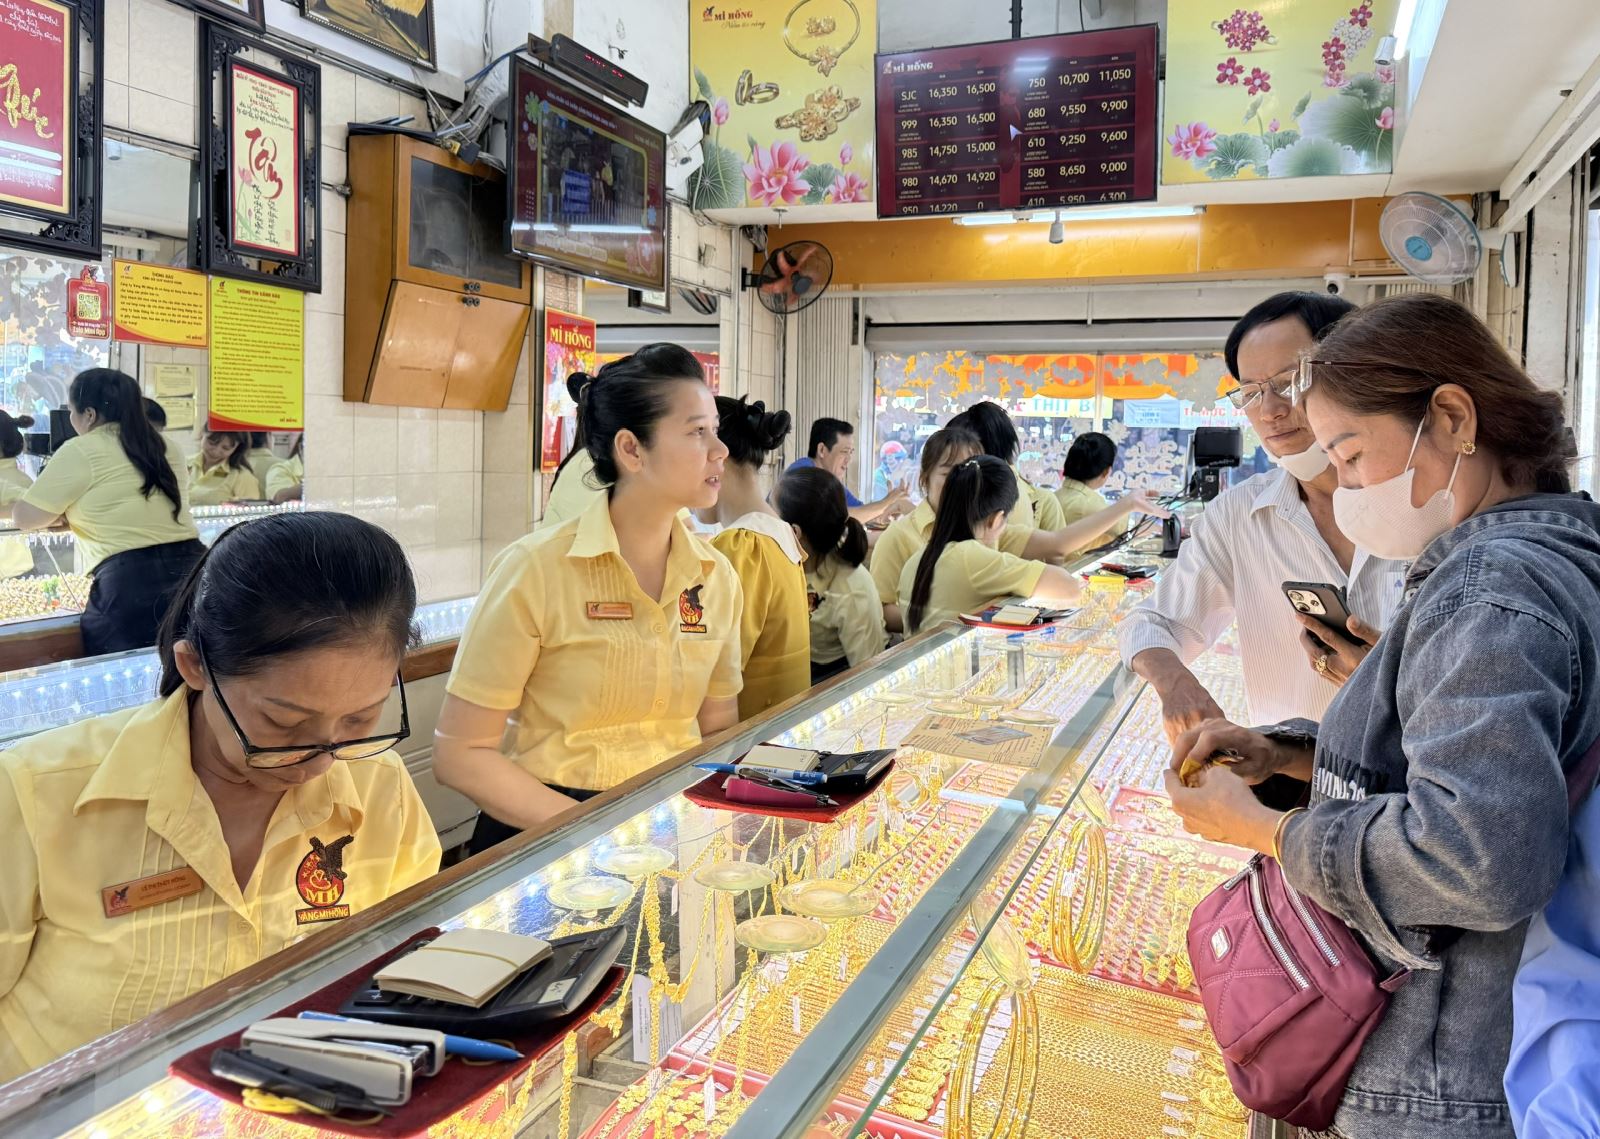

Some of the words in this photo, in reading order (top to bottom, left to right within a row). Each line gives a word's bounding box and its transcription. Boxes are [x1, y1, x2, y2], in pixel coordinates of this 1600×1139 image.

[728, 8, 753, 20] HỒNG
[907, 59, 933, 72] HỒNG
[1028, 78, 1046, 88] 750
[1058, 73, 1090, 86] 10,700
[1100, 68, 1131, 81] 11,050
[901, 90, 917, 101] SJC
[929, 87, 958, 98] 16,350
[966, 83, 996, 95] 16,500
[1028, 108, 1046, 118] 680
[1060, 104, 1086, 116] 9,550
[1101, 100, 1128, 112] 9,900
[901, 120, 918, 130] 999
[929, 116, 958, 128] 16,350
[966, 112, 996, 124] 16,500
[1028, 137, 1045, 148] 610
[1060, 134, 1086, 146] 9,250
[1101, 130, 1127, 143] 9,600
[902, 148, 918, 158] 985
[929, 144, 958, 157] 14,750
[966, 142, 996, 153] 15,000
[1028, 168, 1045, 178] 580
[1060, 165, 1086, 177] 8,650
[1100, 162, 1127, 174] 9,000
[902, 177, 918, 187] 980
[929, 174, 958, 186] 14,670
[967, 171, 996, 183] 14,920
[565, 326, 592, 349] HỒNG
[1032, 398, 1071, 414] THỊT
